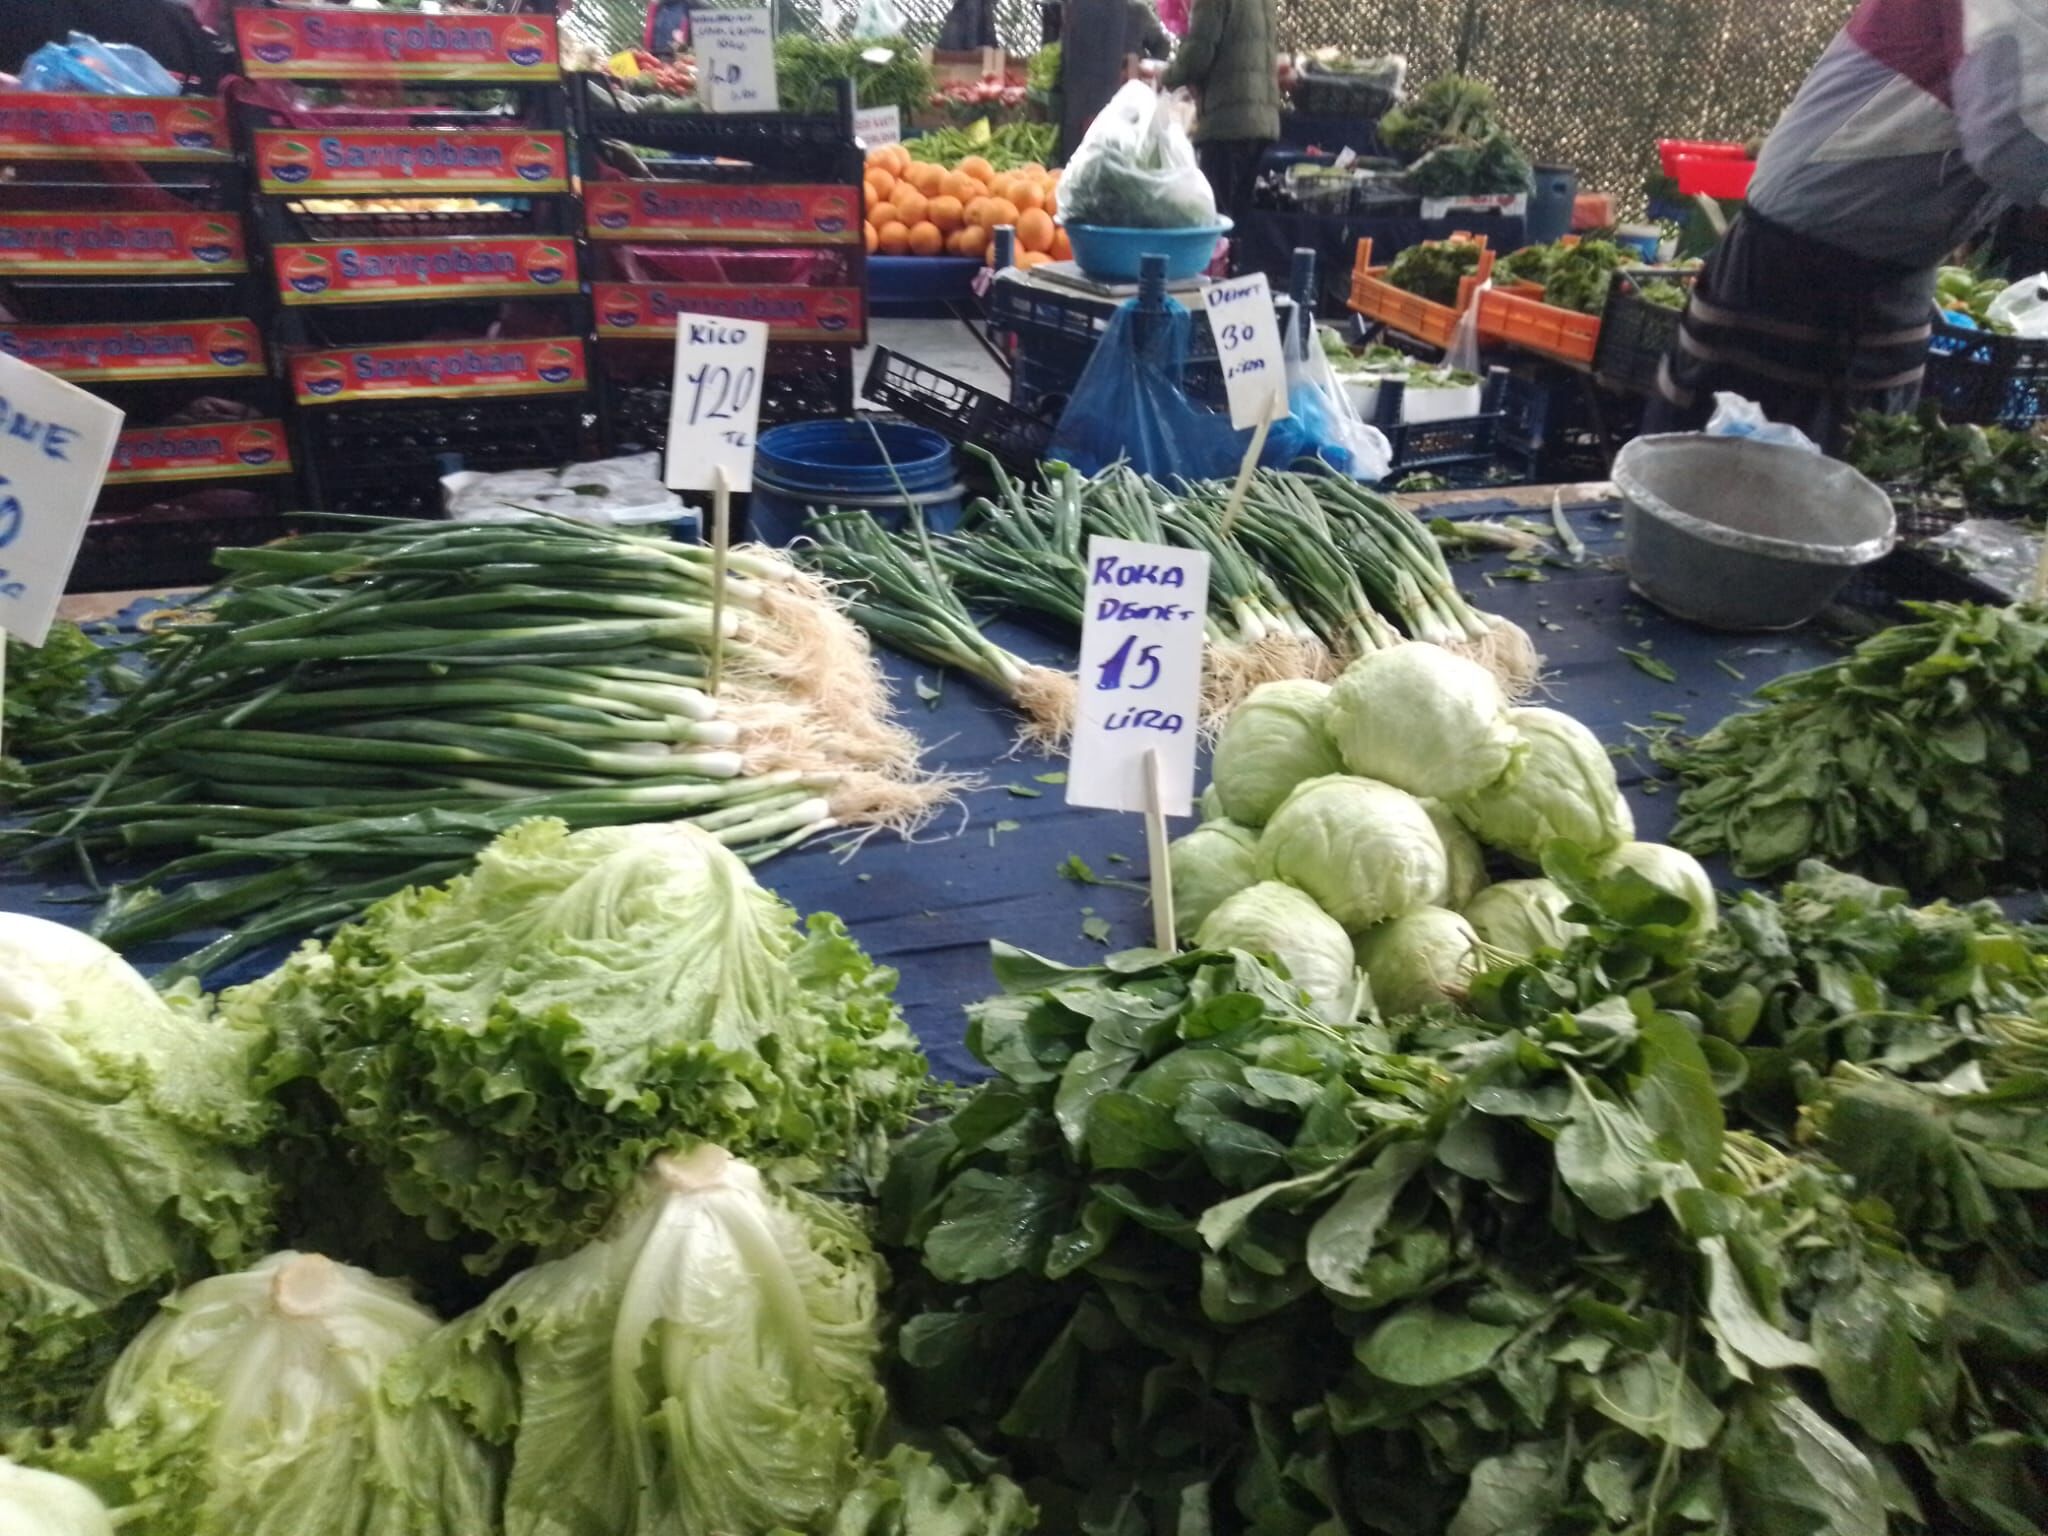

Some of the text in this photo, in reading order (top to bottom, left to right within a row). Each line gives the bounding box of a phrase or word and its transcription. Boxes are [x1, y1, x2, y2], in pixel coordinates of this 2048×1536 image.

[303, 16, 494, 59] Sarıçoban
[319, 136, 503, 175] Sarıçoban
[336, 246, 516, 283] Sarıçoban
[1221, 324, 1254, 350] 30
[353, 348, 527, 384] Sarıçoban
[1093, 556, 1184, 588] ROKA
[1097, 598, 1196, 621] DEMET
[1096, 634, 1163, 691] 15
[1104, 706, 1183, 734] LİRA
